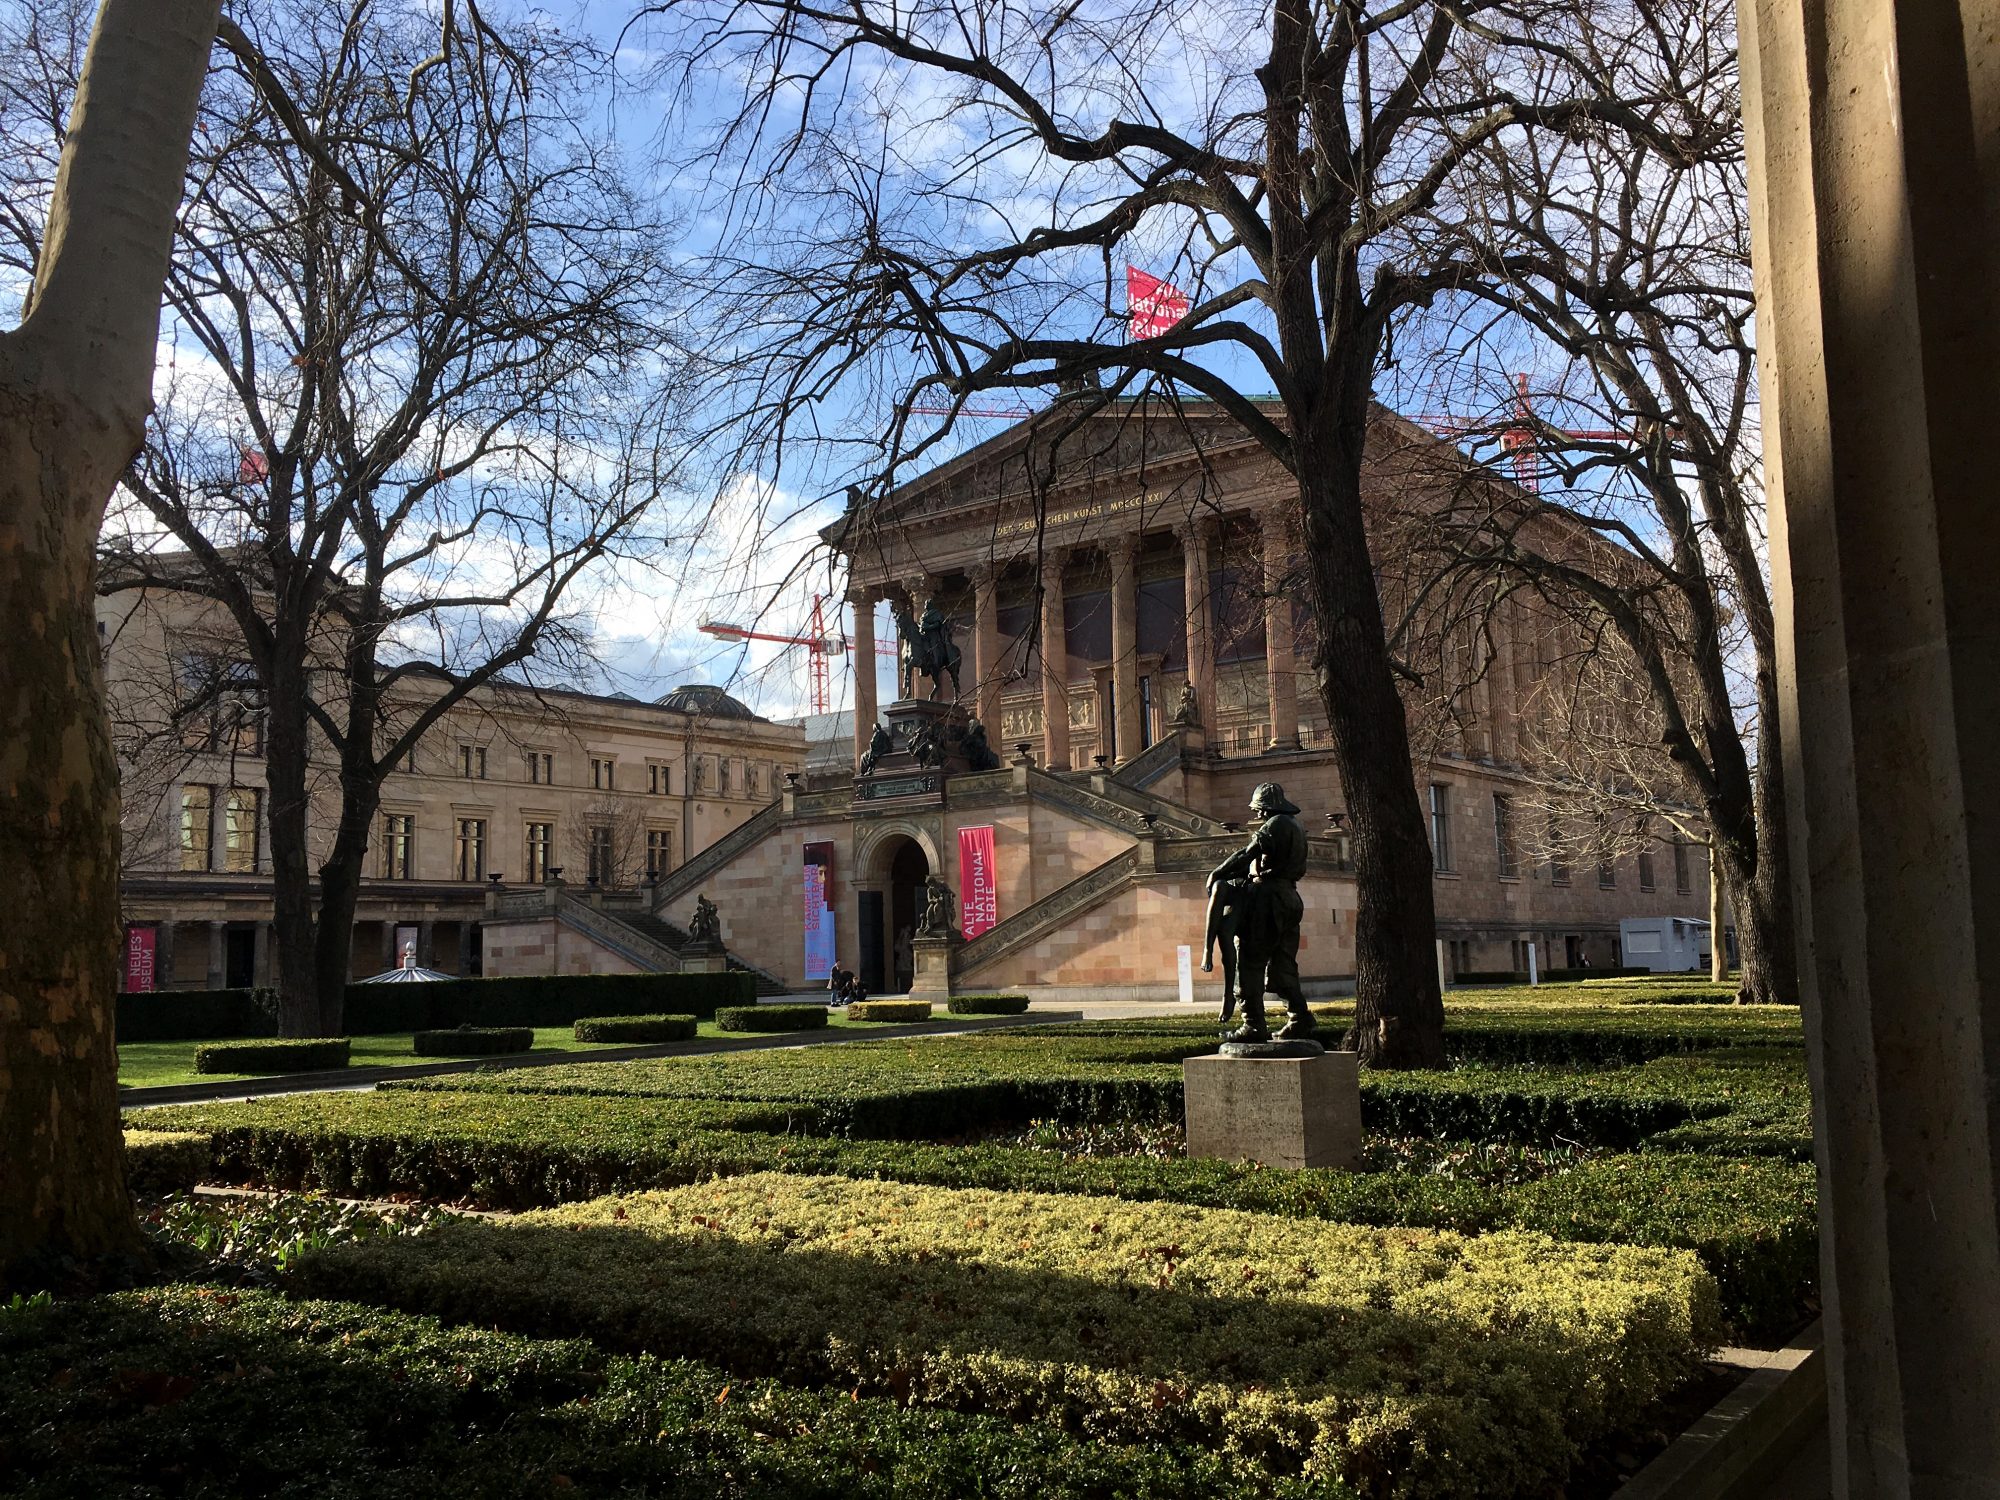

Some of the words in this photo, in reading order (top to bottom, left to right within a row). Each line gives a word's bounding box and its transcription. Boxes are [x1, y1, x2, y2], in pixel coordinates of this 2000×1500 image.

[1018, 513, 1069, 532] DEUCHEN
[1073, 505, 1102, 519] KUNST
[972, 847, 986, 923] NATIONAL
[964, 901, 975, 936] ALTE
[130, 936, 142, 977] NEUES
